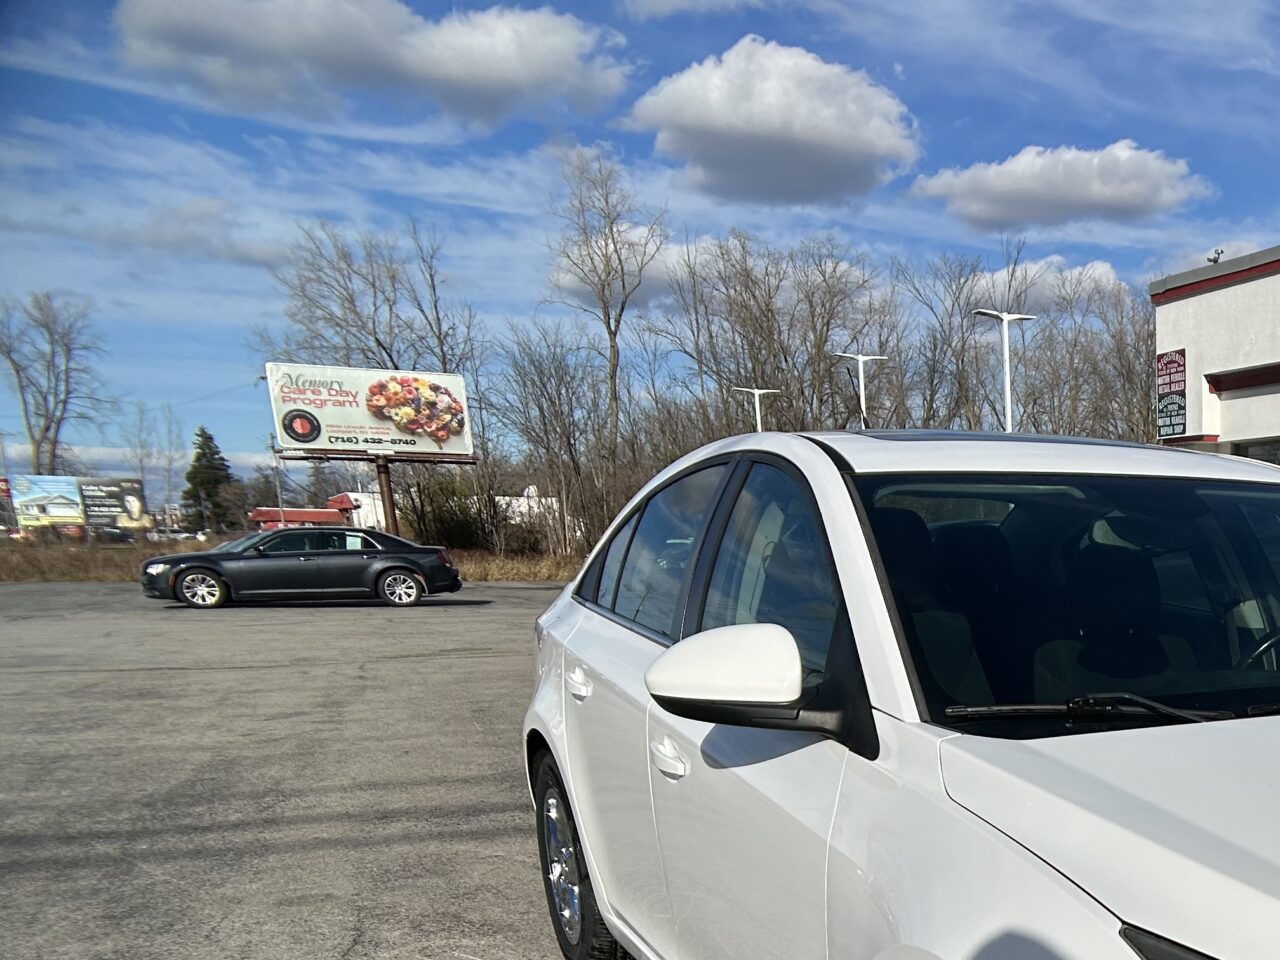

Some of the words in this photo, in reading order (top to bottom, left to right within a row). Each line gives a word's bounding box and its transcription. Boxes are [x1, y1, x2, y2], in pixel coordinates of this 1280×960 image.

[1158, 352, 1185, 370] REGISTERED
[282, 372, 344, 390] Memory
[281, 385, 322, 396] Care
[328, 387, 359, 399] Day
[281, 395, 360, 409] Program
[1158, 394, 1186, 410] REGISTERED
[1173, 424, 1184, 434] SHOP
[328, 435, 359, 445] (716)
[362, 437, 417, 446] 432-8740
